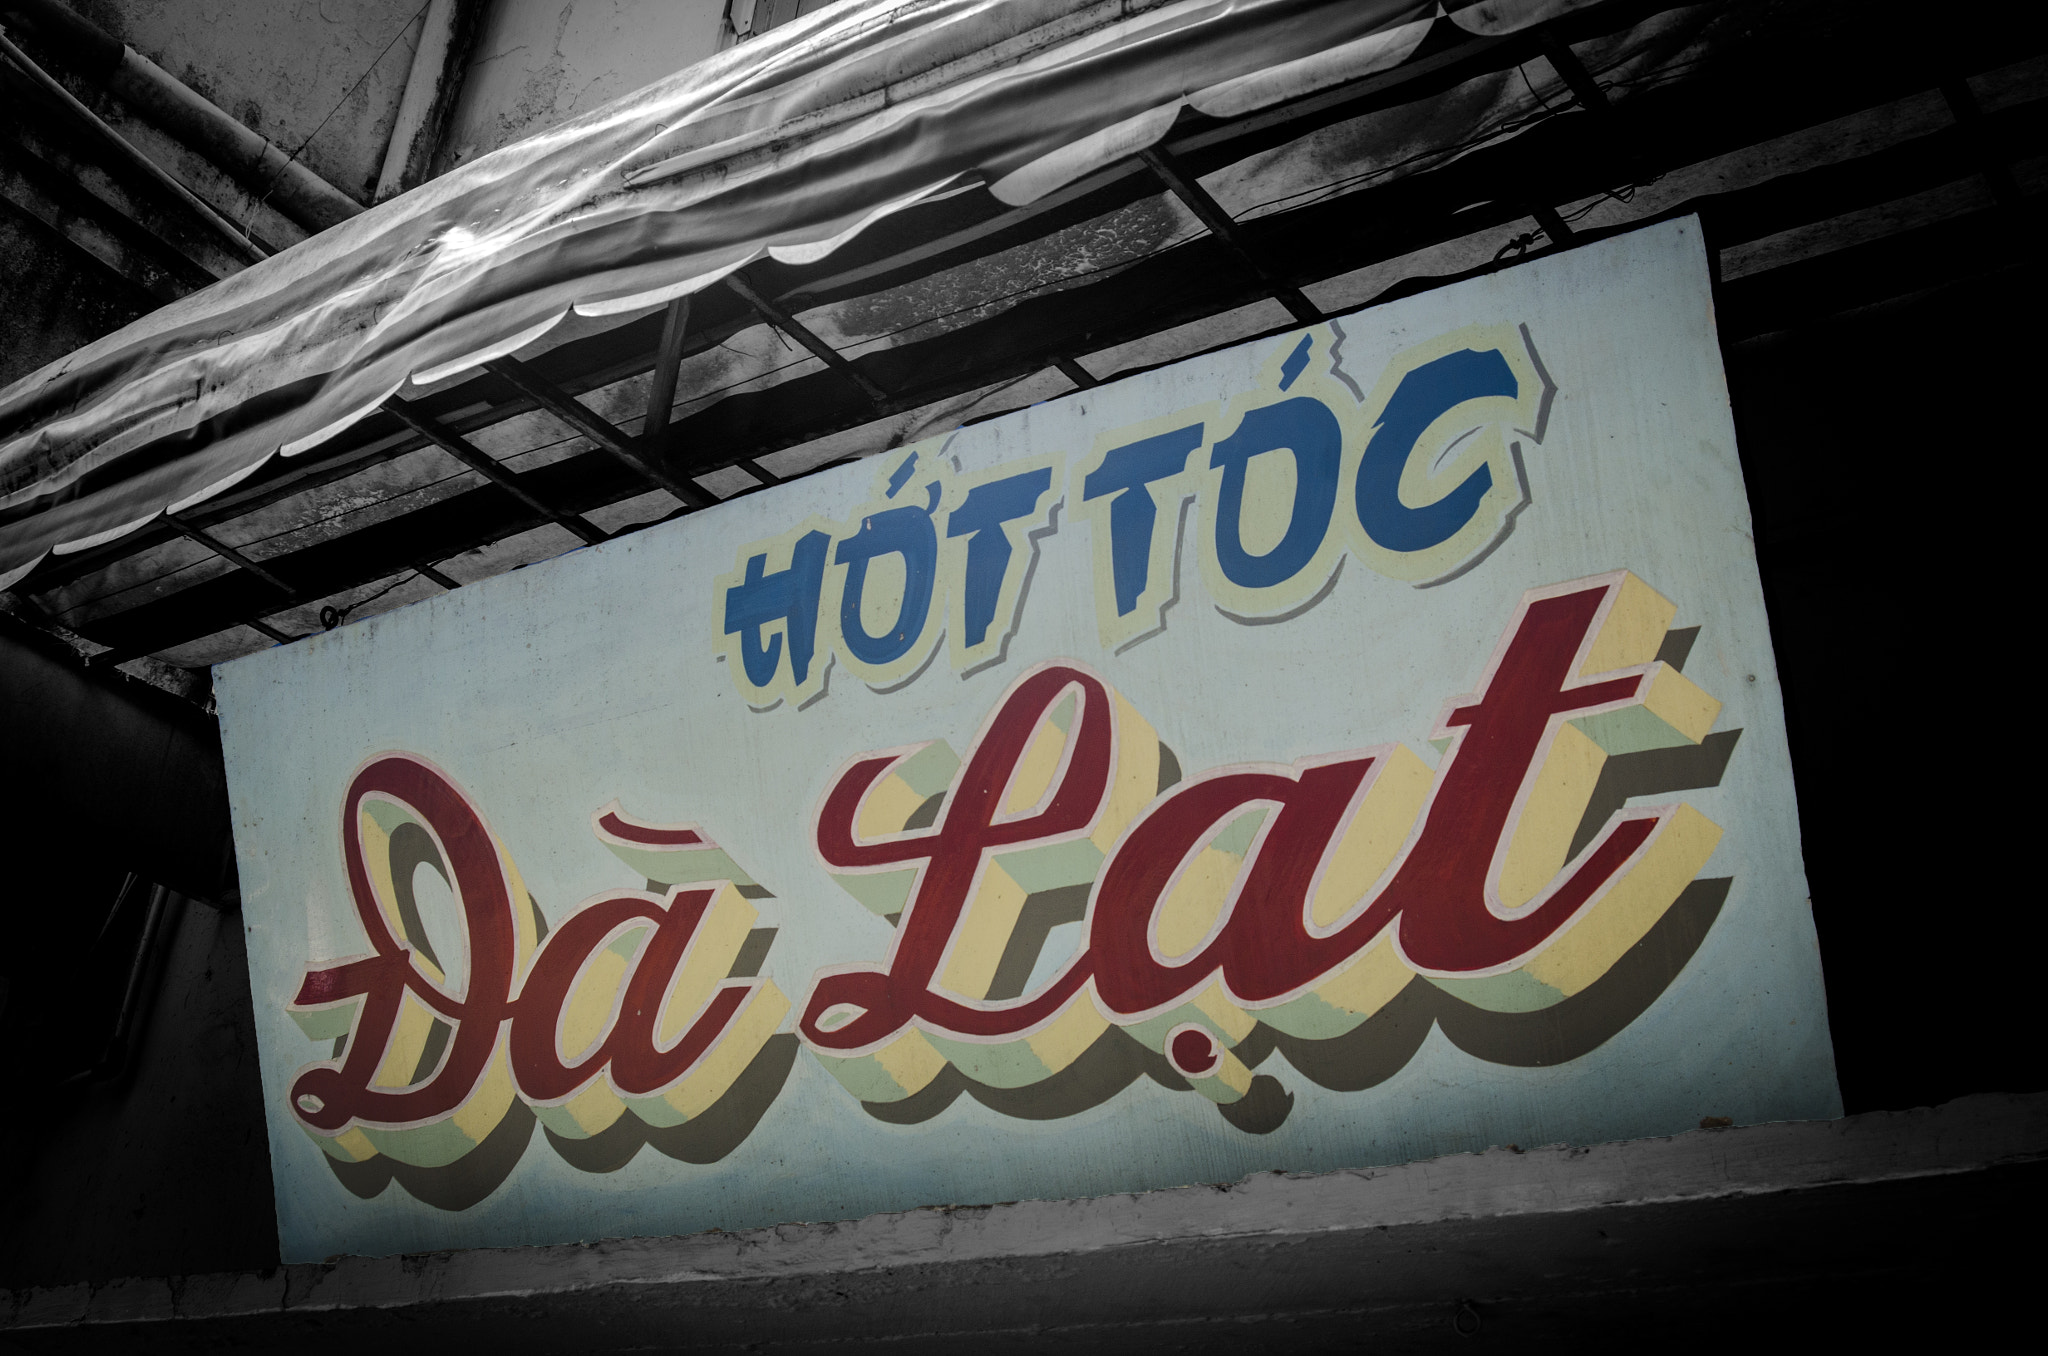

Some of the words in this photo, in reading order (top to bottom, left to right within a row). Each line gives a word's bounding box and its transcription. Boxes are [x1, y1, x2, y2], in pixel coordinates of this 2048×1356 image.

[725, 451, 1053, 688] HỚT
[1083, 332, 1519, 617] TÓC
[286, 754, 764, 1132] Đà
[798, 582, 1664, 1078] Lạt
